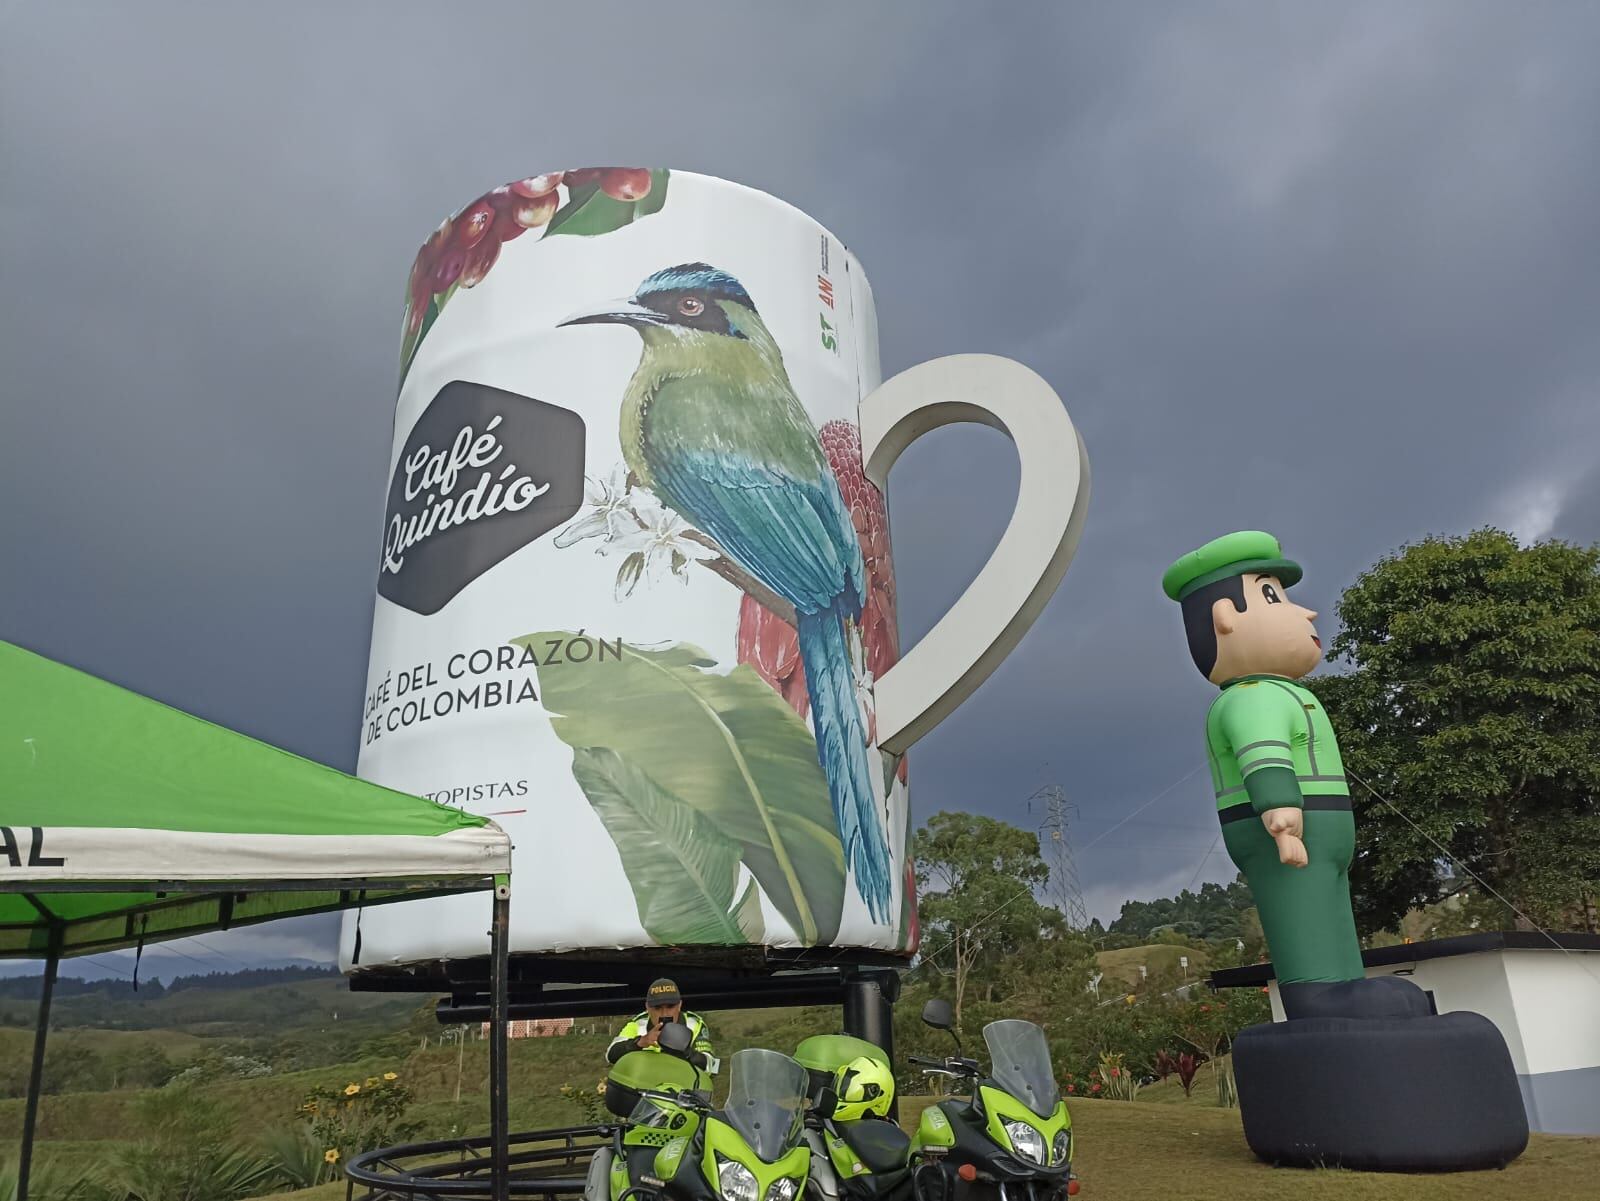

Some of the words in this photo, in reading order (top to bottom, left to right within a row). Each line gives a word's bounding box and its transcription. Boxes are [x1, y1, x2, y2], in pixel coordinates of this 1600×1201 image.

[405, 415, 503, 501] Café
[382, 464, 550, 574] Quindío
[366, 670, 391, 720] CAFÉ
[397, 663, 438, 697] DEL
[447, 629, 622, 680] CORAZÓN
[367, 715, 382, 746] DE
[387, 677, 539, 732] COLOMBIA
[421, 780, 528, 806] TOPISTAS
[650, 985, 677, 995] POLICIA
